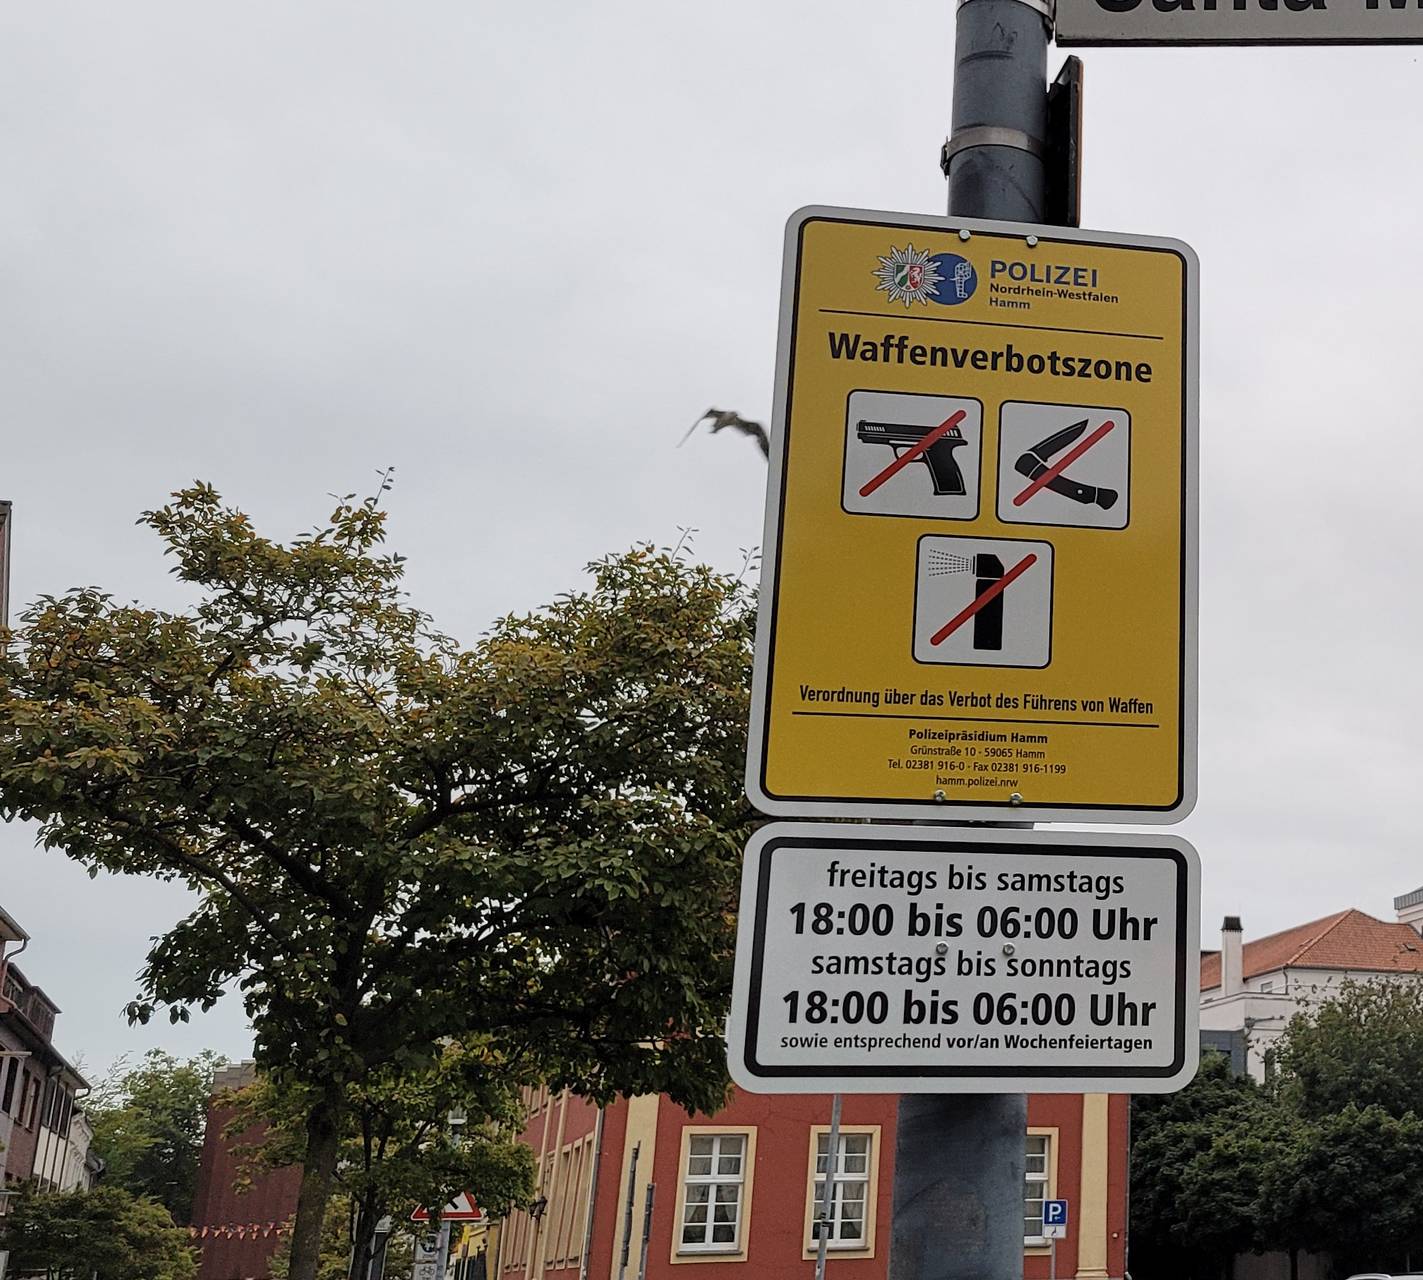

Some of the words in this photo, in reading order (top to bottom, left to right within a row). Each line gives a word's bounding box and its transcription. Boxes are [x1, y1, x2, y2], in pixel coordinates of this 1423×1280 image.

[990, 261, 1097, 287] POLIZEI
[990, 283, 1118, 304] Nordrhein-Westfalen
[990, 297, 1030, 309] Hamm
[829, 332, 1153, 382] Waffenverbotszone
[800, 685, 880, 707] Verordnung
[885, 689, 916, 705] über
[920, 690, 943, 706] das
[949, 691, 991, 708] Verbot
[996, 693, 1019, 709] des
[1024, 694, 1077, 711] Führens
[1081, 700, 1104, 712] von
[1109, 697, 1153, 714] Waffen
[909, 729, 1007, 743] Polizeipräsidium
[1011, 733, 1047, 743] Hamm
[911, 745, 961, 756] Grünstraße
[965, 747, 976, 756] 10
[985, 748, 1013, 757] 59065
[1016, 749, 1045, 758] Hamm
[888, 759, 903, 768] Tel.
[906, 760, 933, 769] 02381
[938, 761, 964, 770] 916-0
[974, 762, 988, 771] Fax
[991, 763, 1018, 772] 02381
[1023, 764, 1066, 774] 916-1199
[936, 775, 1018, 788] hamm.polizei.nrw
[827, 861, 937, 896] freitags
[948, 864, 986, 890] bis
[997, 871, 1124, 900] samstags
[790, 903, 893, 936] 18:00
[908, 903, 962, 937] bis
[977, 906, 1078, 939] 06:00
[1093, 907, 1157, 940] Uhr
[812, 956, 945, 982] samstags
[957, 950, 996, 976] bis
[1006, 956, 1131, 985] sonntags
[783, 991, 888, 1024] 18:00
[903, 990, 958, 1024] bis
[973, 992, 1075, 1026] 06:00
[1090, 992, 1156, 1026] Uhr
[781, 1033, 828, 1047] sowie
[834, 1033, 941, 1052] entsprechend
[947, 1034, 999, 1048] vor/an
[1004, 1034, 1152, 1053] Wochenfeiertagen
